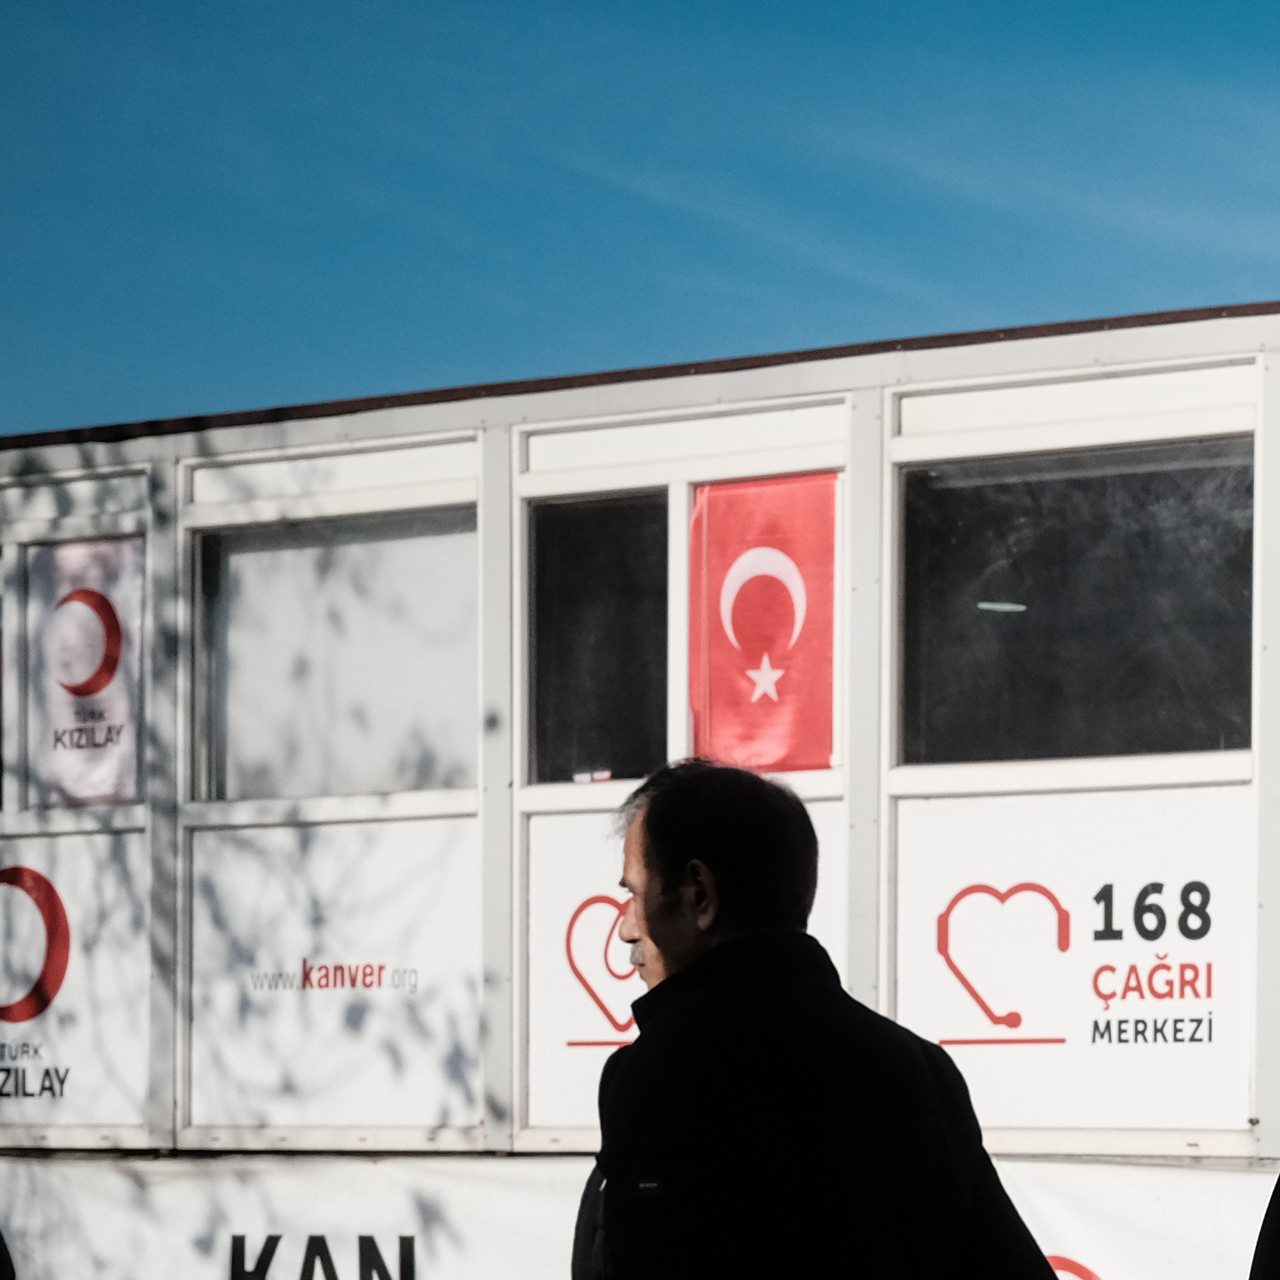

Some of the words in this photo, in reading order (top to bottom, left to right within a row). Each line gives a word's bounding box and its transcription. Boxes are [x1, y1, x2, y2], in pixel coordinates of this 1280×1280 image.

[1093, 880, 1212, 942] 168
[1092, 952, 1213, 1012] ÇAĞRI
[1091, 1011, 1213, 1044] MERKEZİ
